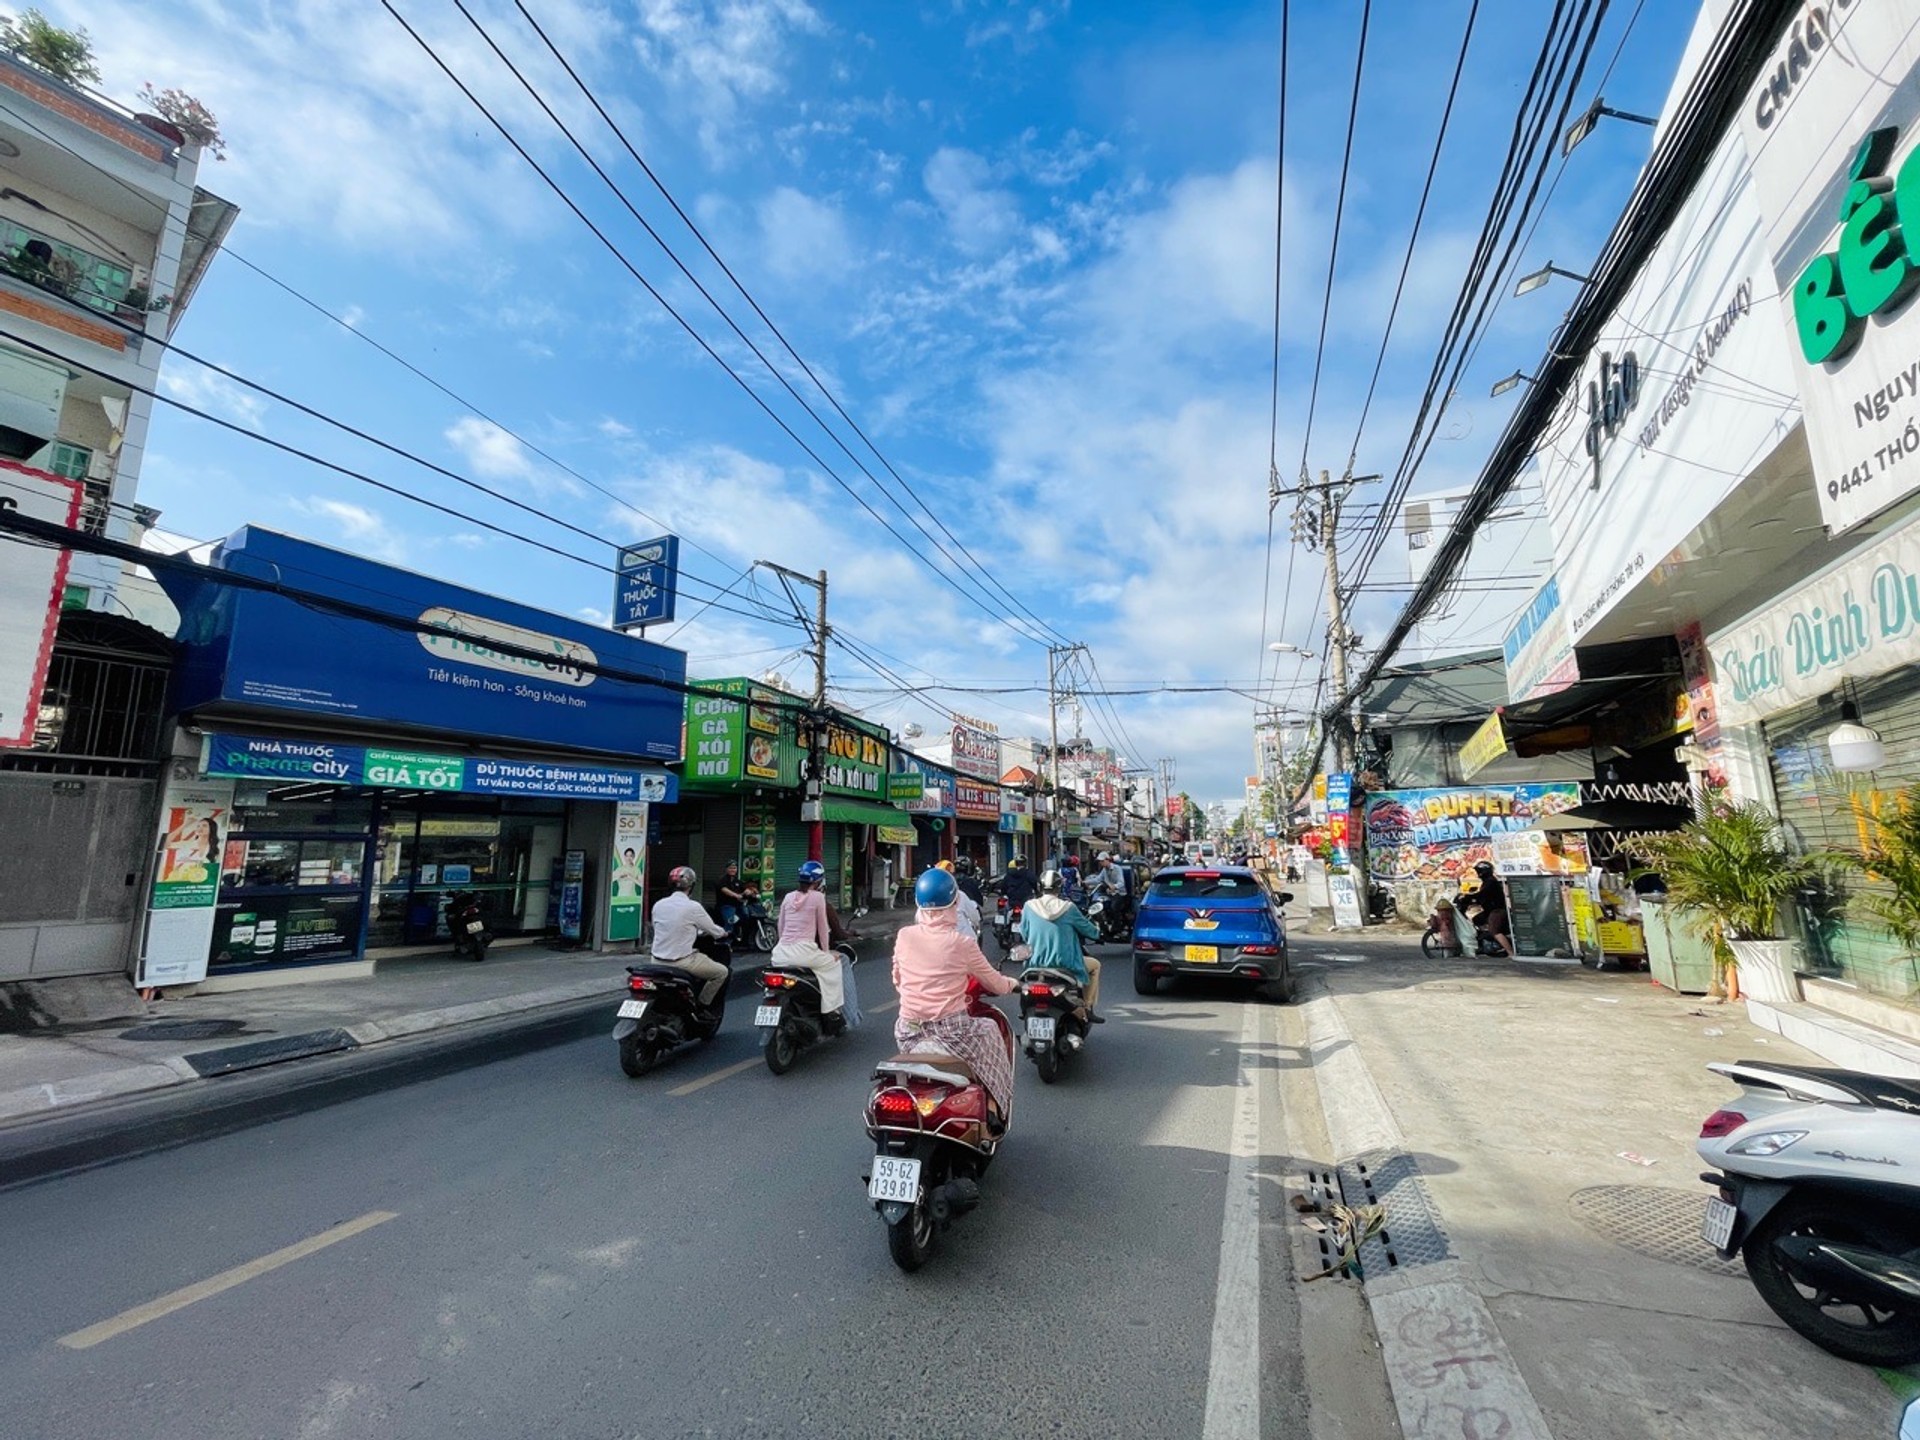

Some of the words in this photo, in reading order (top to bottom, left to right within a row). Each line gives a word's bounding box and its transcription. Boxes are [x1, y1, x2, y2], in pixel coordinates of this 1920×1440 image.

[1755, 7, 1825, 131] CHÁO
[1793, 127, 1920, 365] BẾ
[1853, 360, 1920, 429] Nguy
[1840, 460, 1873, 494] 441
[1874, 416, 1920, 471] THỐ
[630, 603, 649, 619] TÂY
[1722, 634, 1782, 702] Cháo
[1786, 589, 1868, 675] Dinh
[248, 742, 282, 753] NHÀ
[285, 745, 335, 758] THUỐC
[227, 752, 350, 779] Pharmacity
[368, 765, 412, 784] GIÁ
[415, 766, 460, 788] TỐT
[499, 765, 544, 779] THUỐC
[1424, 793, 1514, 820] BUFFET
[1338, 892, 1353, 905] XE
[879, 1160, 914, 1180] 59-G2
[873, 1178, 914, 1199] 139.81
